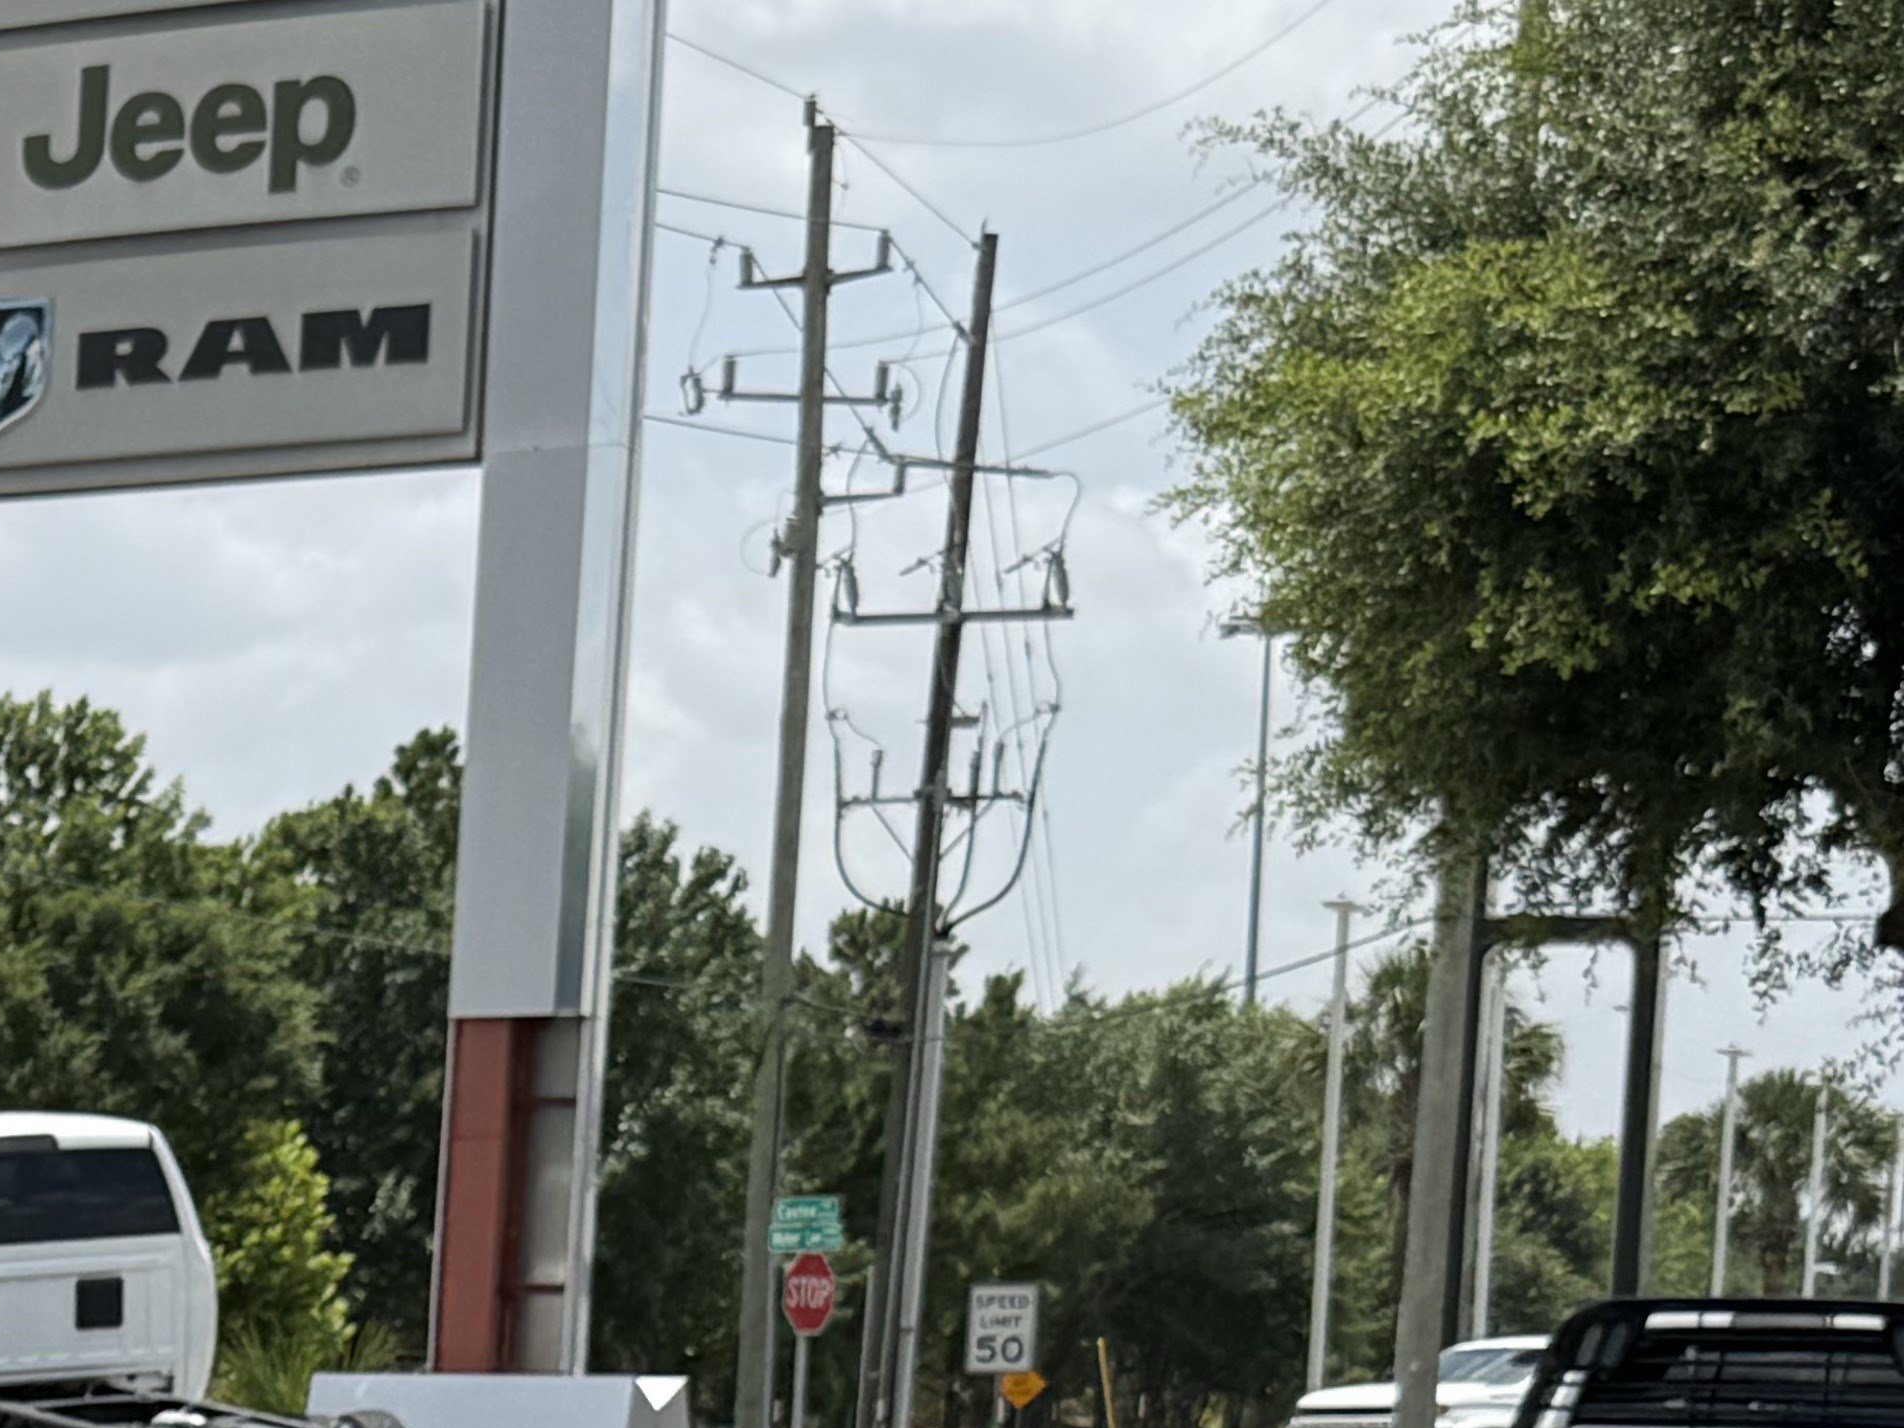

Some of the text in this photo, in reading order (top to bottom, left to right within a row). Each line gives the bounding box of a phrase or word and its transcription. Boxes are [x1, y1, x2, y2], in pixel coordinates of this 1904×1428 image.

[22, 65, 356, 194] Jeep
[76, 304, 431, 390] RAM
[786, 1276, 833, 1309] STOP
[976, 1294, 1030, 1310] SPEED
[980, 1315, 1022, 1329] LIMIT
[975, 1335, 1024, 1364] 50
